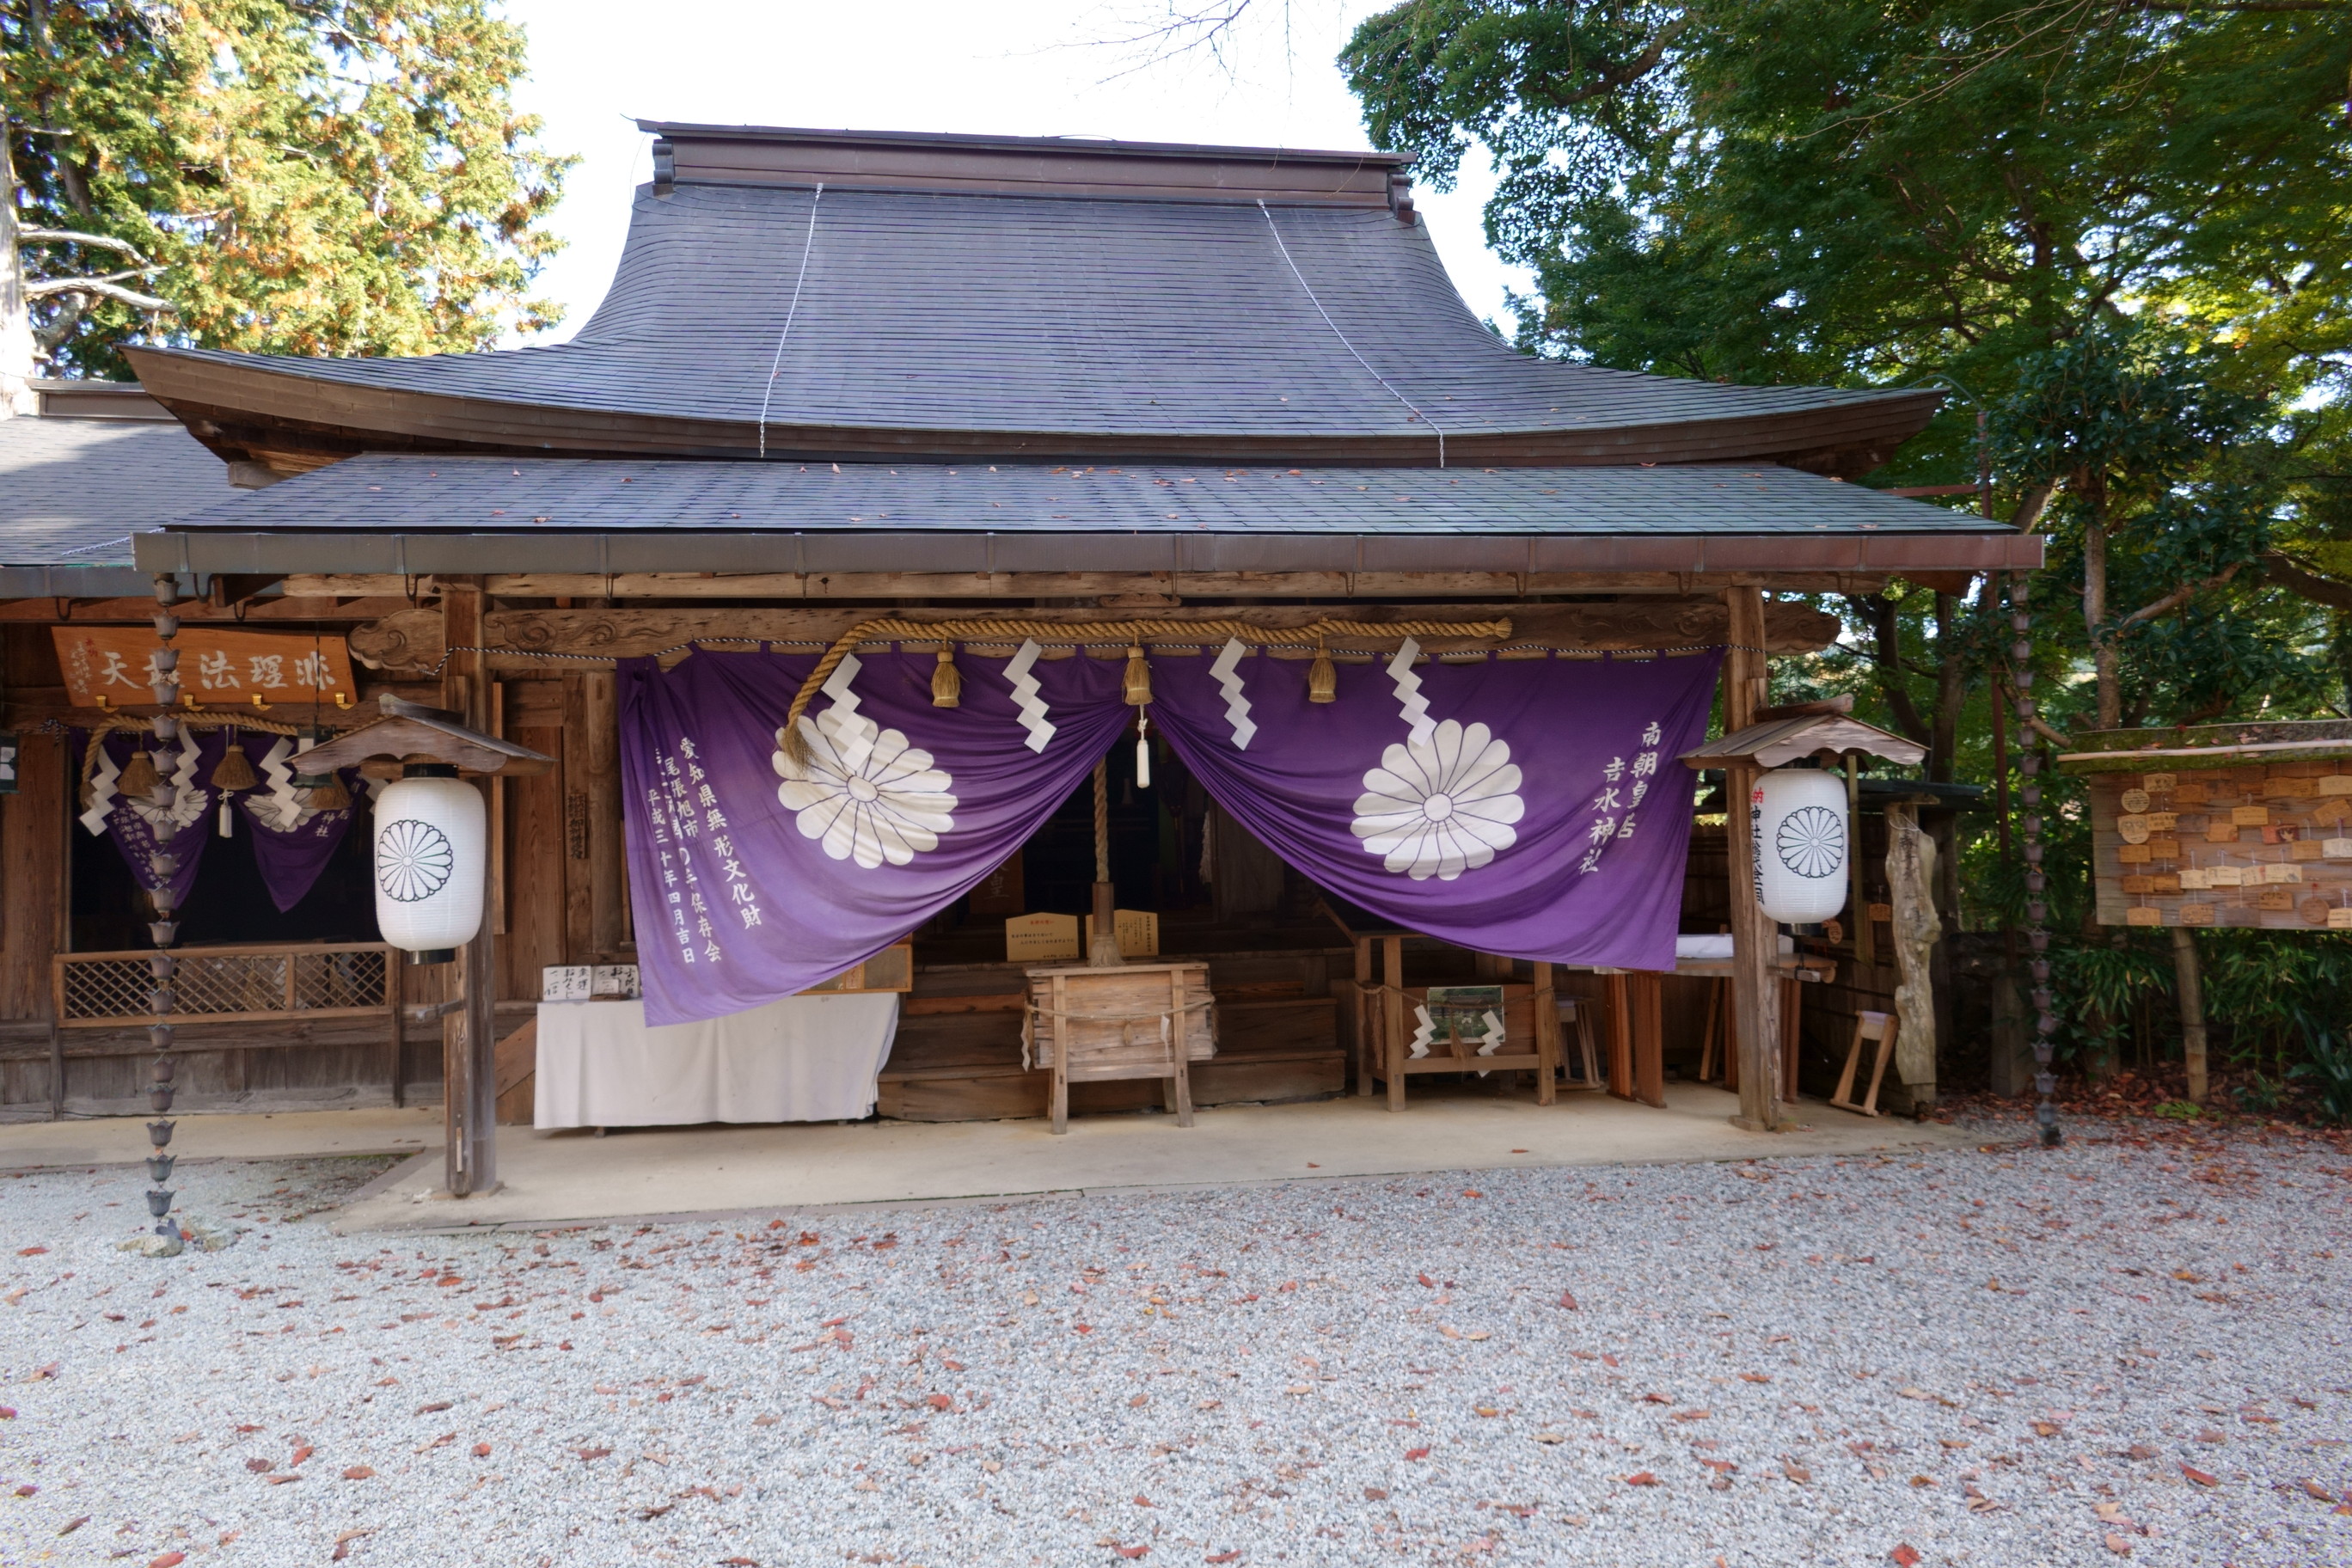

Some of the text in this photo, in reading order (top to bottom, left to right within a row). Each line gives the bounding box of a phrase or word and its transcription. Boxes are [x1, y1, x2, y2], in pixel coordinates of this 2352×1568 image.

[664, 756, 699, 838] 尾張旭市
[679, 737, 763, 929] 愛知県無形文化財
[1578, 756, 1626, 875] 吉水神社
[1618, 721, 1663, 839] 南朝皇居
[647, 788, 695, 964] 平成三十年四月吉日
